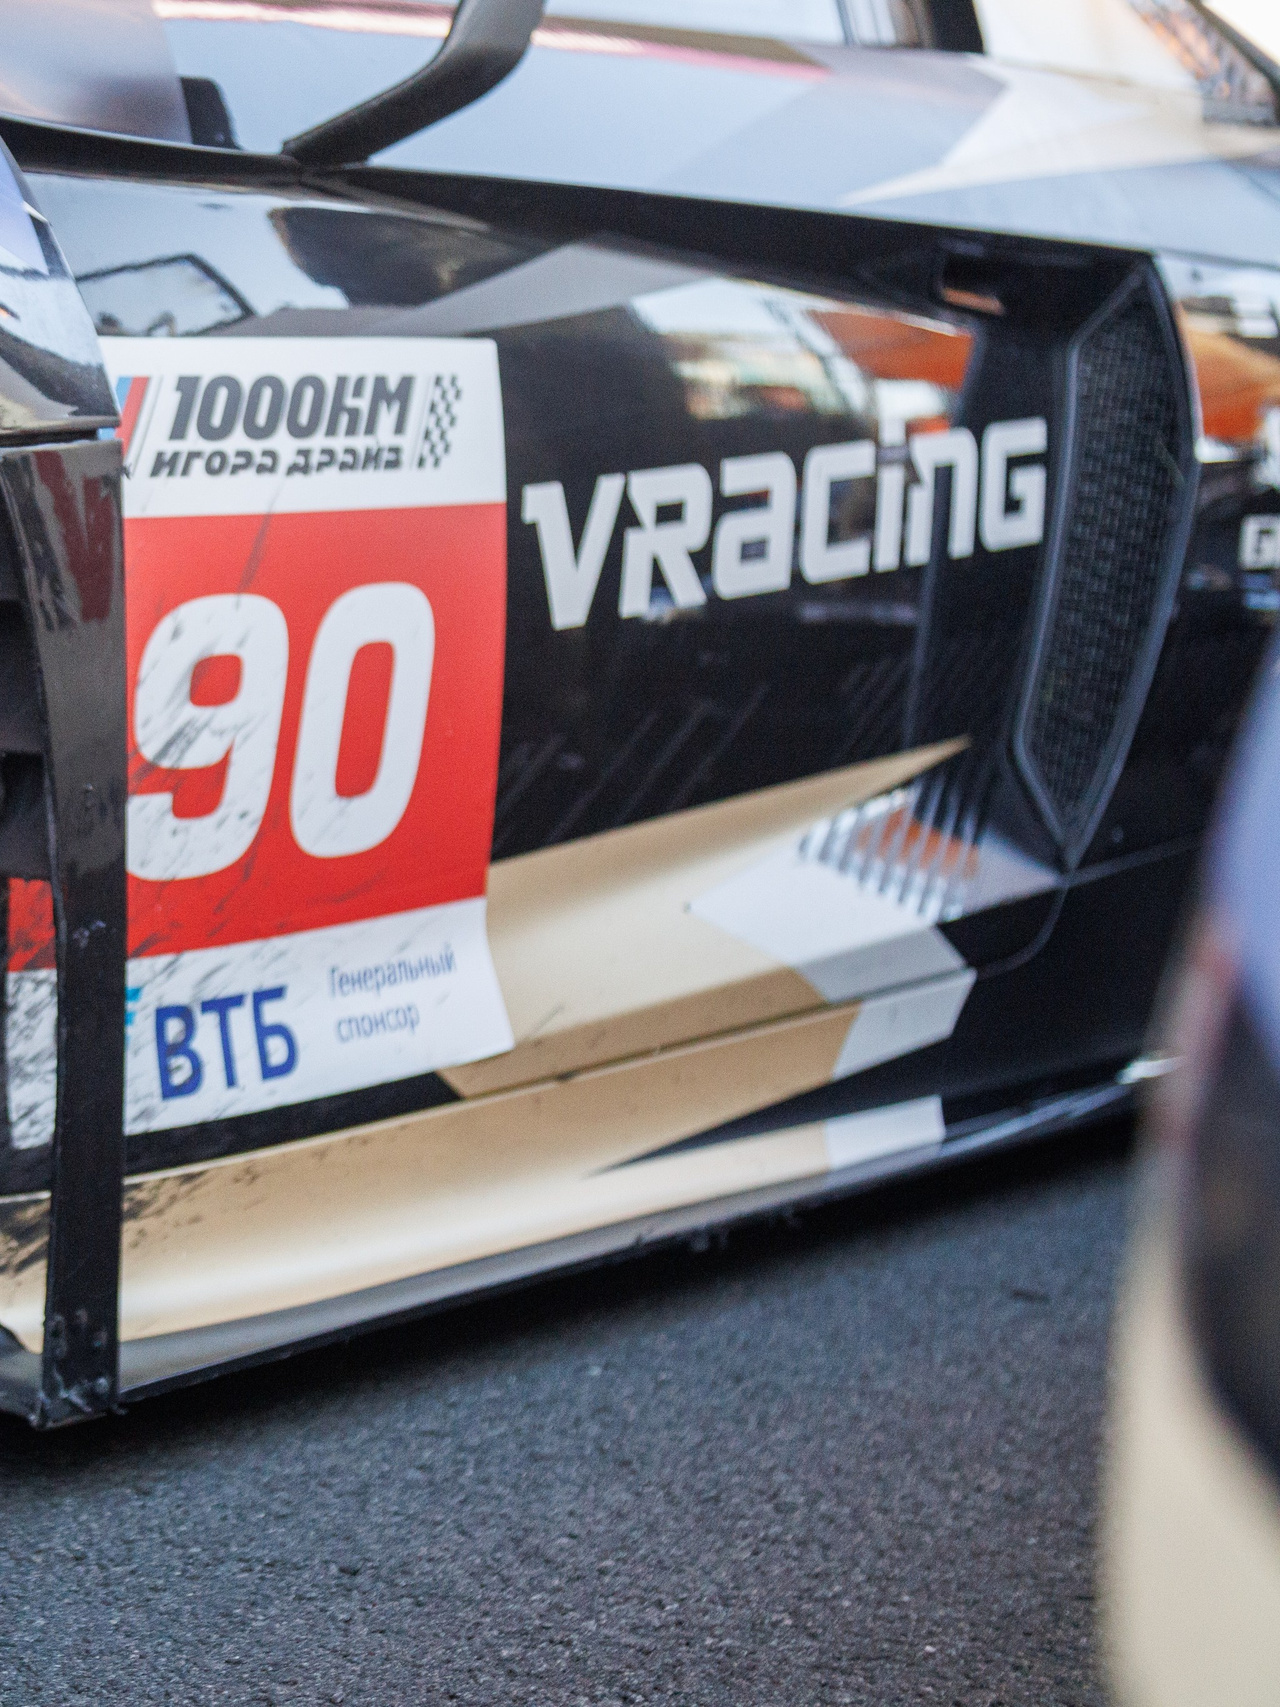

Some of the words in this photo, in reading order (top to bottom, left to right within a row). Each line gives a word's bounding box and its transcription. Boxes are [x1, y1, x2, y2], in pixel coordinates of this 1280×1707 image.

[150, 450, 280, 478] ИГОРА
[125, 580, 436, 882] 90
[329, 942, 457, 997] Генеральный
[155, 984, 300, 1101] ВТБ
[336, 1003, 420, 1043] спонсор
